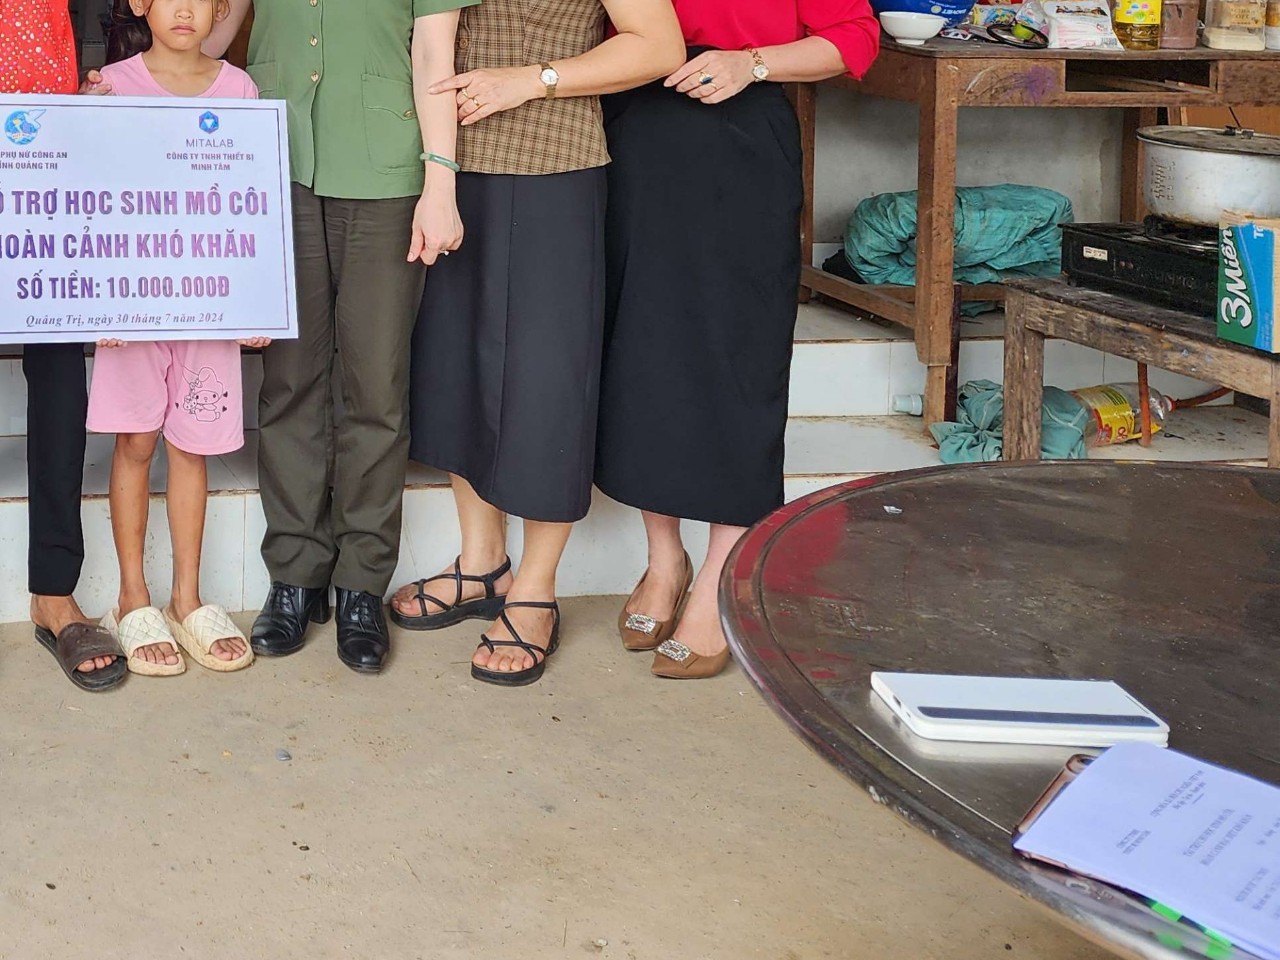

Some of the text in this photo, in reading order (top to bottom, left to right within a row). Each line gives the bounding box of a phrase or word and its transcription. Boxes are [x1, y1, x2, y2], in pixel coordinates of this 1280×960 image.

[186, 139, 234, 148] MITALAB
[0, 151, 17, 160] PHỤ
[32, 150, 54, 159] CÔNG
[166, 151, 188, 160] CÔNG
[223, 151, 244, 160] THIẾT
[246, 154, 254, 162] BỊ
[15, 161, 43, 170] QUẢNG
[45, 162, 58, 170] TRỊ
[214, 162, 231, 171] TÂM
[11, 188, 58, 220] TRỢ
[65, 190, 113, 220] HỌC
[120, 190, 178, 215] SINH
[185, 183, 222, 215] MỒ
[228, 186, 268, 215] CÔI
[63, 226, 129, 259] CẢNH
[136, 228, 184, 258] KHÓ
[191, 228, 256, 258] KHĂN
[16, 269, 230, 299] SỐ TIỀN: 10.000.000Đ
[26, 312, 224, 327] Quảng Trị, ngày 30 tháng 7 năm 2024
